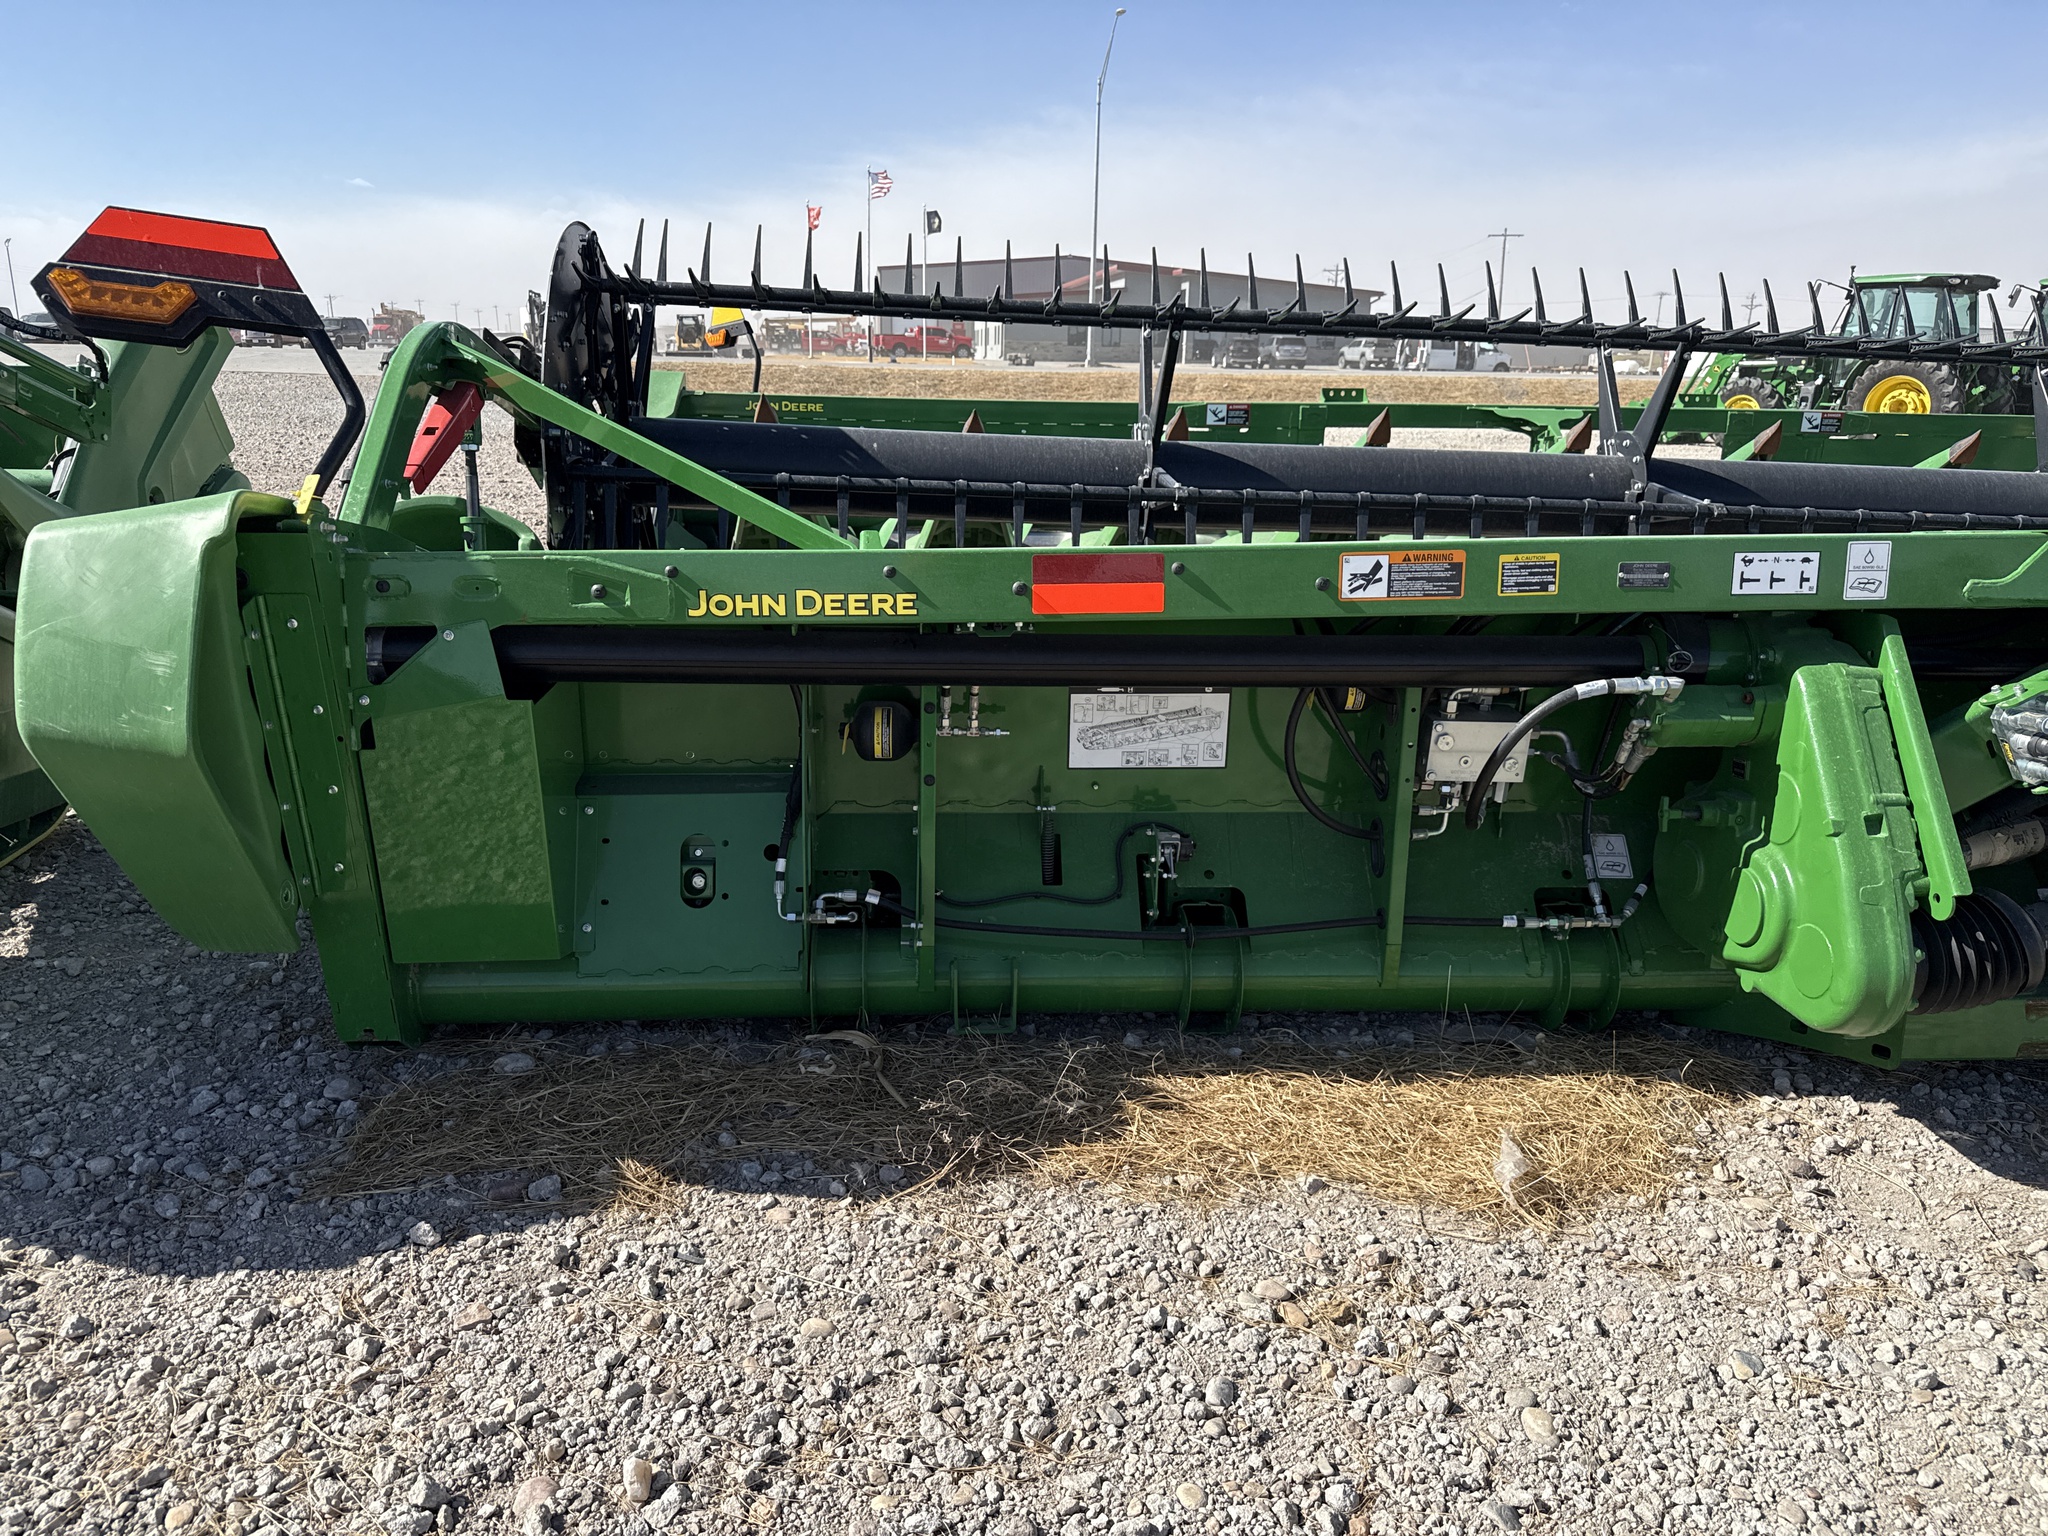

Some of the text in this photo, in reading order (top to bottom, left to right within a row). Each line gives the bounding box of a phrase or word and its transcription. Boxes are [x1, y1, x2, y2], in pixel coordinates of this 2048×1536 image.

[745, 400, 824, 412] JON DEERE
[1412, 553, 1454, 562] WARNING
[687, 588, 918, 617] JOHN DEERE
